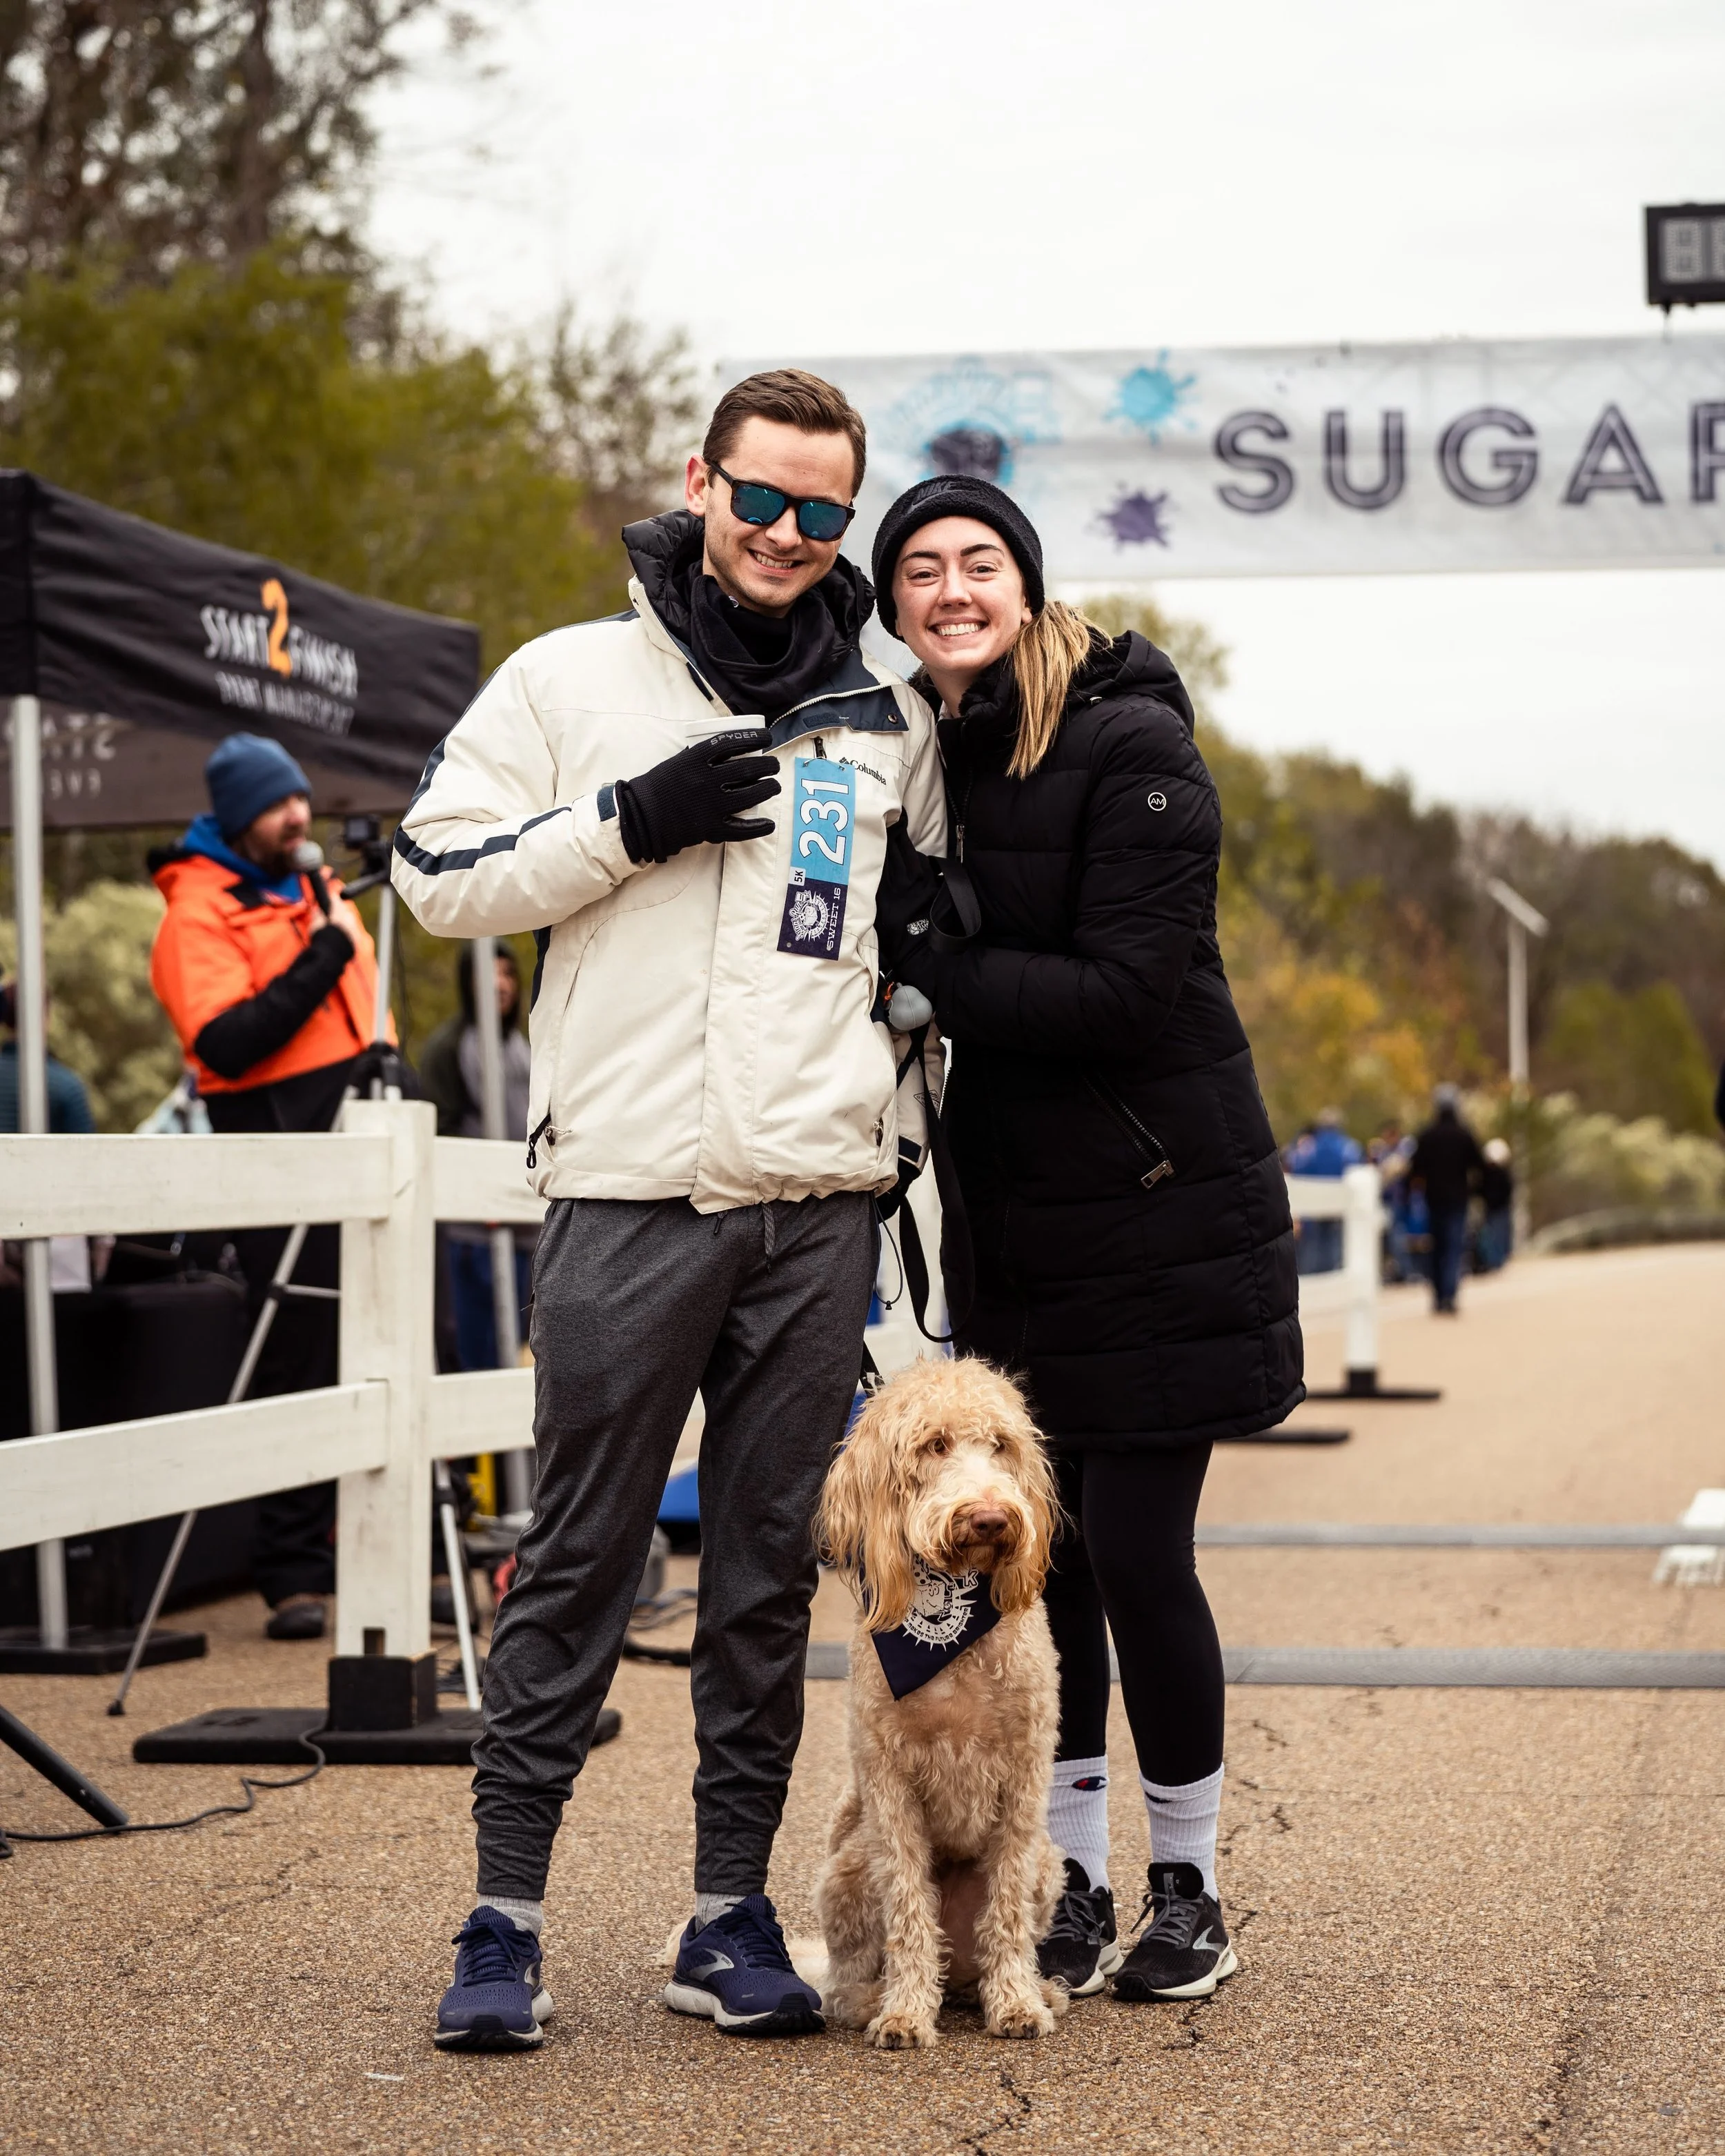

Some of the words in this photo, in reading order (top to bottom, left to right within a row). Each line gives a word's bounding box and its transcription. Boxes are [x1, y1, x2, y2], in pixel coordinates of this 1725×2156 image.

[200, 604, 270, 669] START
[261, 578, 292, 679] 2
[710, 731, 758, 745] SPYDER
[849, 760, 887, 785] Columbia
[798, 778, 849, 865] 231
[794, 870, 803, 883] 5K
[827, 903, 839, 948] SWEET
[834, 887, 841, 900] 16
